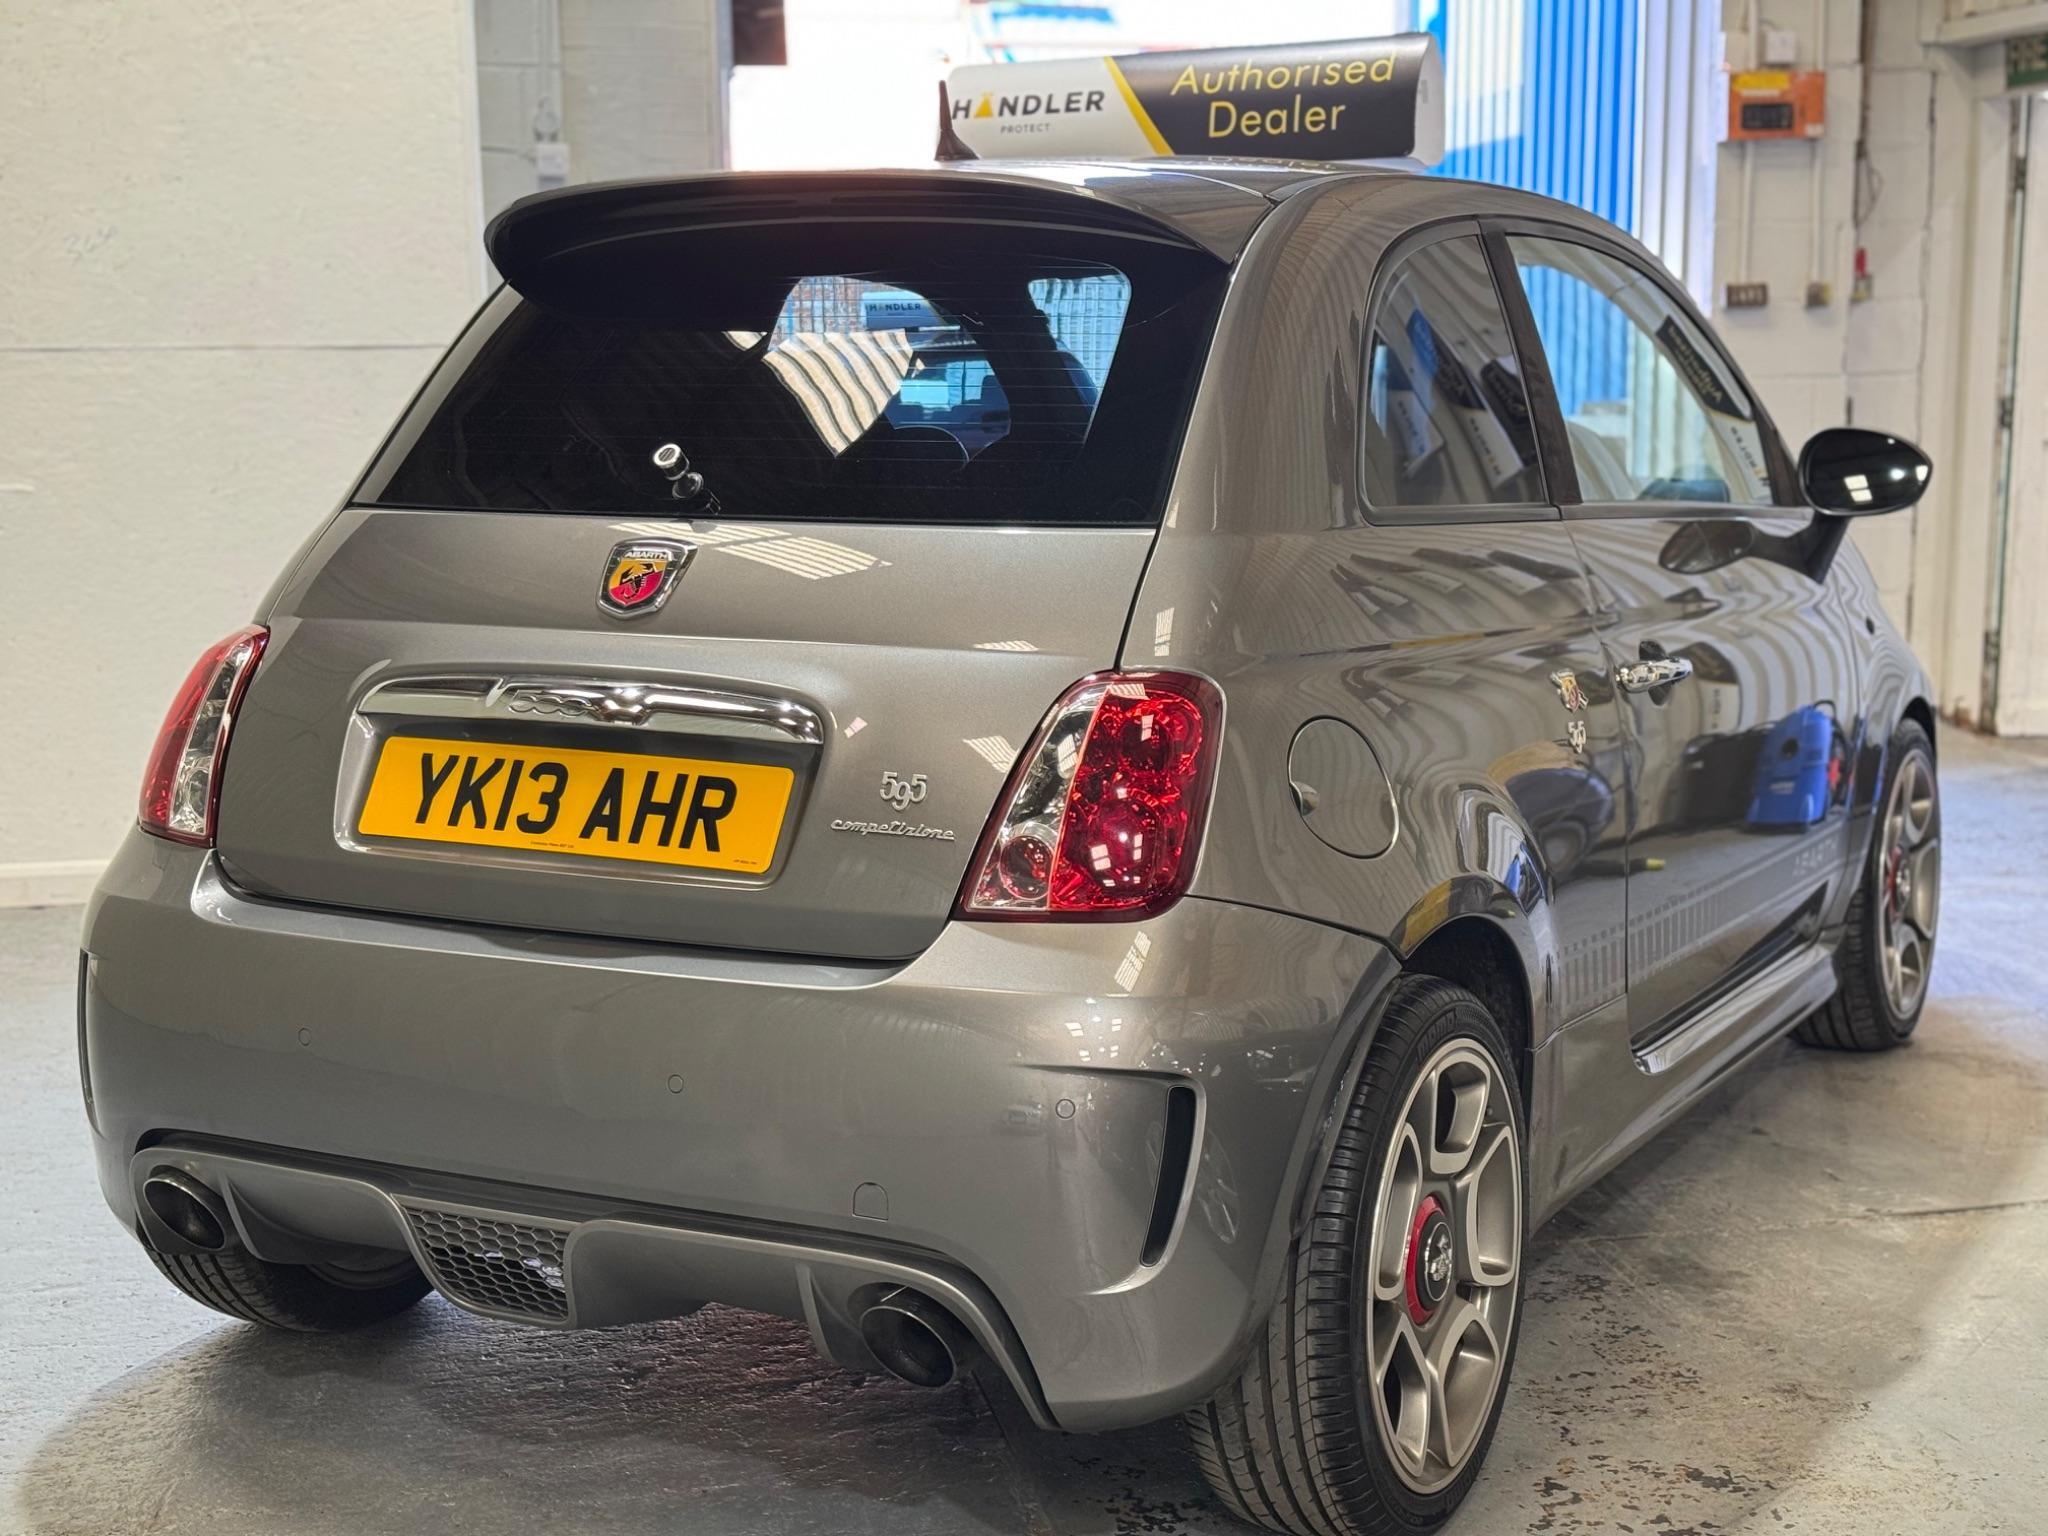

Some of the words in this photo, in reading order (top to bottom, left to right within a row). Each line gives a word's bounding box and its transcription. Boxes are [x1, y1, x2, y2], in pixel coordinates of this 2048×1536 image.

[1169, 50, 1397, 97] Authorised
[1000, 122, 1051, 135] PROTECT
[1208, 94, 1346, 139] Dealer
[624, 550, 668, 560] ABARTH
[415, 753, 569, 835] YK13
[578, 767, 738, 853] AHR
[879, 771, 928, 811] 595
[830, 819, 955, 842] competizione
